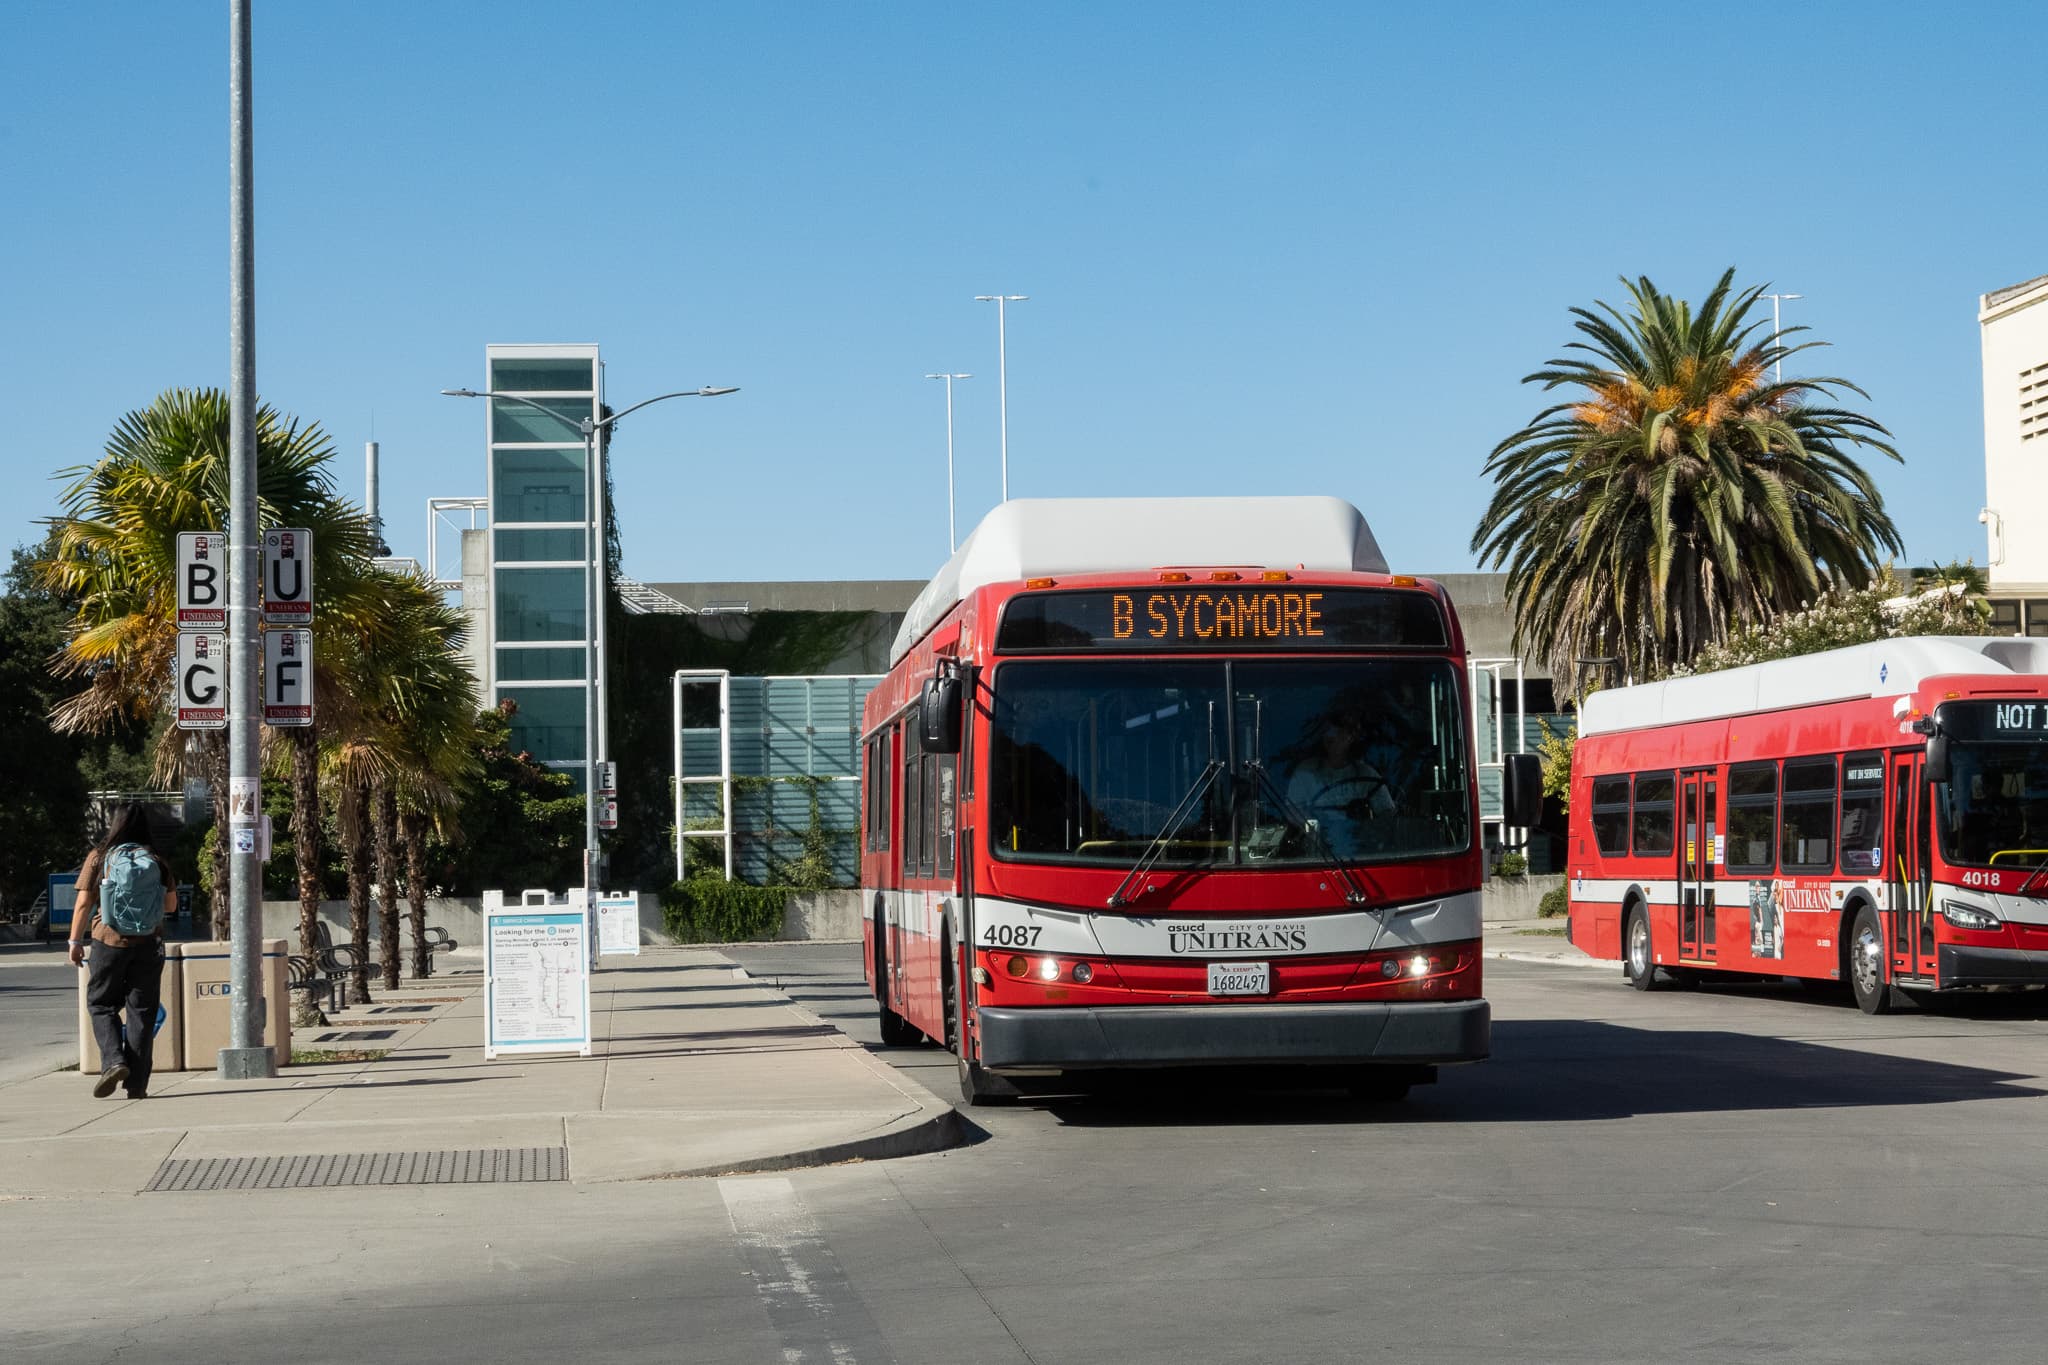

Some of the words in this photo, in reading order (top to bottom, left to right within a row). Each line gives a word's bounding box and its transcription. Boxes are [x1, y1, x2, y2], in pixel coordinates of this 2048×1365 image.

[187, 563, 218, 605] B
[273, 560, 302, 601] U
[183, 612, 222, 621] UNITRANS
[1113, 595, 1134, 638] B
[1148, 593, 1324, 637] SYCAMORE
[184, 664, 219, 705] G
[277, 661, 302, 703] F
[183, 711, 222, 721] UNITRANS
[269, 708, 309, 718] UNITRANS
[1996, 704, 2036, 729] NOT
[603, 772, 613, 788] E
[1848, 769, 1857, 780] NOT
[1857, 769, 1864, 779] IN
[1864, 768, 1882, 779] SERVICE
[1962, 871, 2000, 886] 4018
[1783, 889, 1831, 913] UNITRANS
[983, 924, 1043, 947] 4087
[1167, 923, 1205, 932] asucd
[1168, 930, 1307, 953] UNITRANS
[1212, 974, 1266, 991] 1682497
